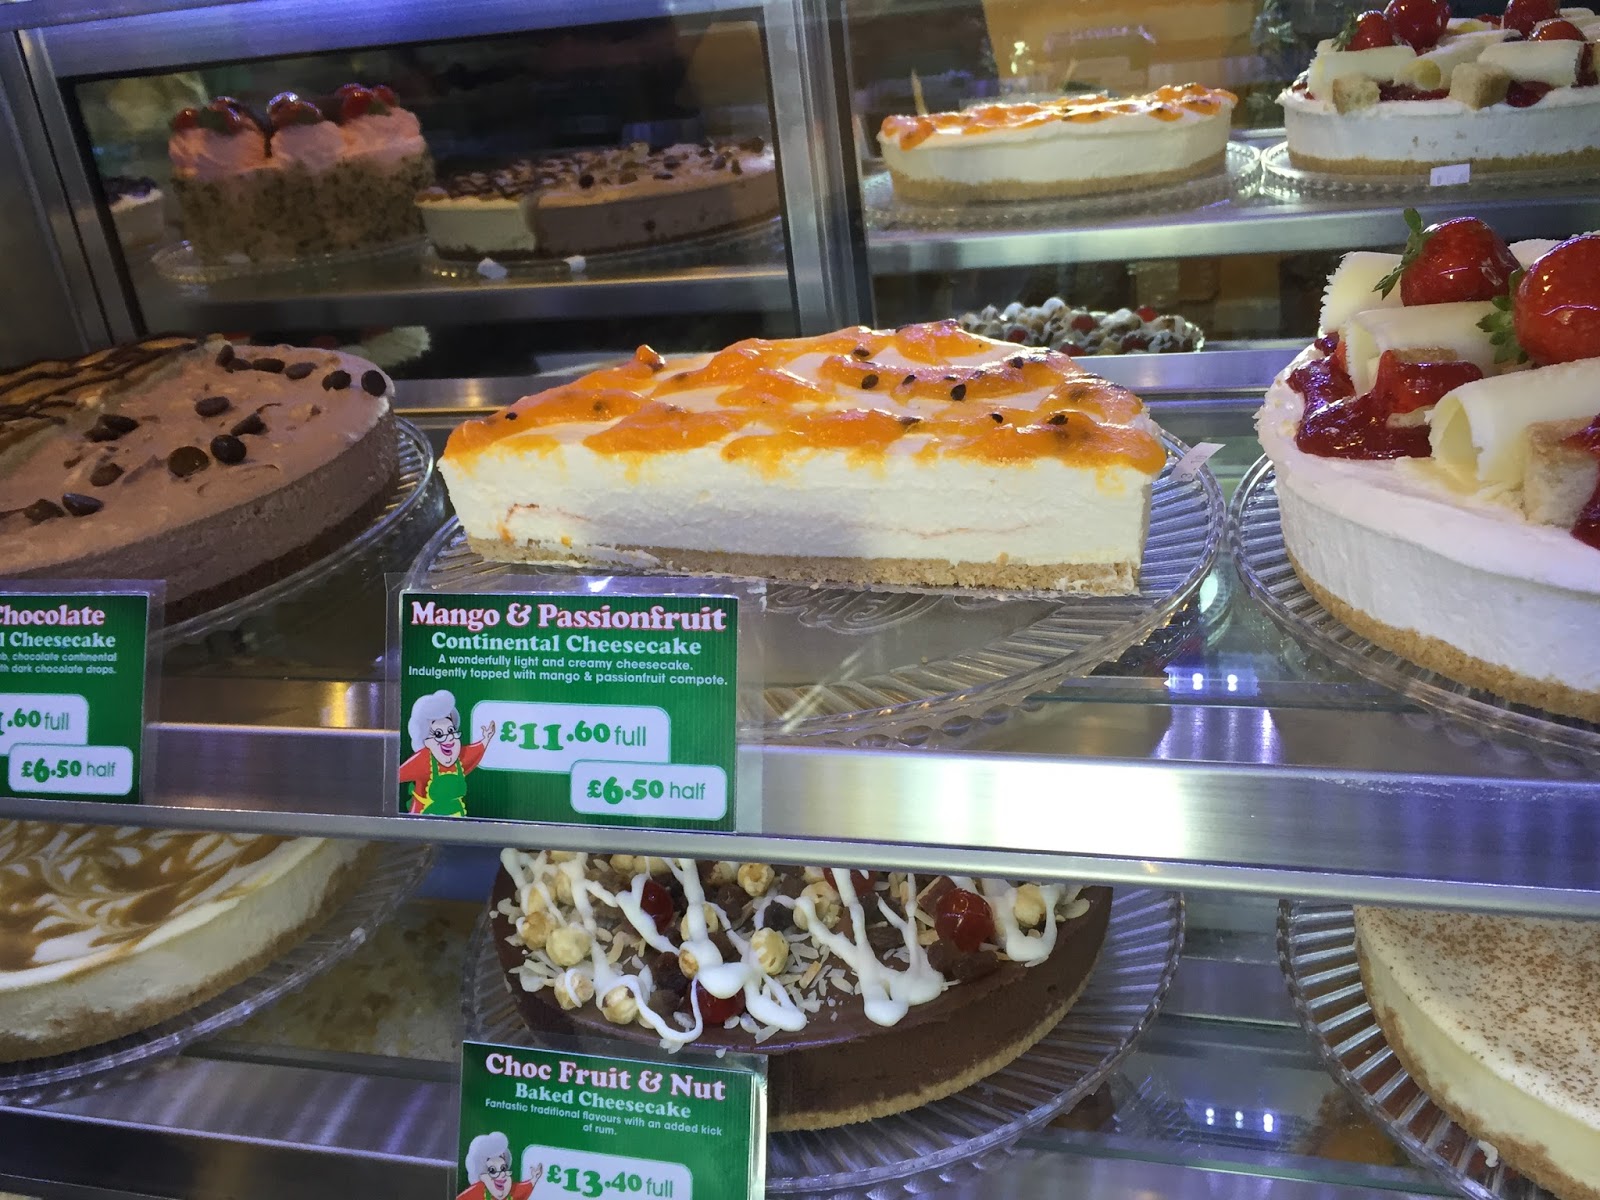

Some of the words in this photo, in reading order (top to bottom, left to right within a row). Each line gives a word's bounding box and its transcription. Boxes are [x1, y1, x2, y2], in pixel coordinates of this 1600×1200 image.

[410, 601, 500, 632] Mango
[506, 602, 532, 627] &
[537, 603, 727, 631] Passionfruit
[9, 631, 116, 648] Cheesecake
[431, 631, 560, 652] Continental
[566, 635, 702, 655] Cheesecake
[11, 664, 33, 673] dark
[35, 664, 83, 674] chocolate
[12, 652, 59, 661] chocolate
[62, 652, 117, 662] continental
[438, 654, 446, 664] A
[449, 654, 511, 667] wonderfully
[514, 655, 539, 669] light
[542, 657, 564, 667] and
[568, 658, 613, 670] creamy
[616, 658, 693, 671] cheesecake.
[408, 666, 467, 679] Indulgently
[470, 668, 510, 680] topped
[513, 669, 536, 680] with
[539, 671, 580, 684] mango
[584, 671, 592, 682] &
[596, 673, 666, 684] passionfruit
[669, 674, 728, 685] compote.
[44, 712, 69, 730] full
[500, 720, 611, 751] £11.60
[614, 726, 647, 747] full
[21, 757, 82, 783] £6.50
[86, 762, 116, 777] half
[587, 776, 664, 805] £6.50
[669, 782, 706, 800] half
[485, 1052, 552, 1081] Choc
[558, 1060, 632, 1090] Fruit
[638, 1070, 663, 1093] &
[670, 1073, 726, 1101] Nut
[515, 1082, 574, 1105] Baked
[578, 1090, 692, 1119] Cheesecake
[485, 1098, 528, 1112] Fantastic
[530, 1104, 580, 1119] traditional
[582, 1110, 622, 1124] flavours
[624, 1116, 645, 1127] with
[648, 1120, 661, 1129] an
[664, 1122, 698, 1134] added
[701, 1125, 722, 1136] kick
[582, 1123, 593, 1132] of
[595, 1126, 617, 1136] rum.
[546, 1164, 642, 1198] £13.40
[646, 1177, 673, 1198] full
